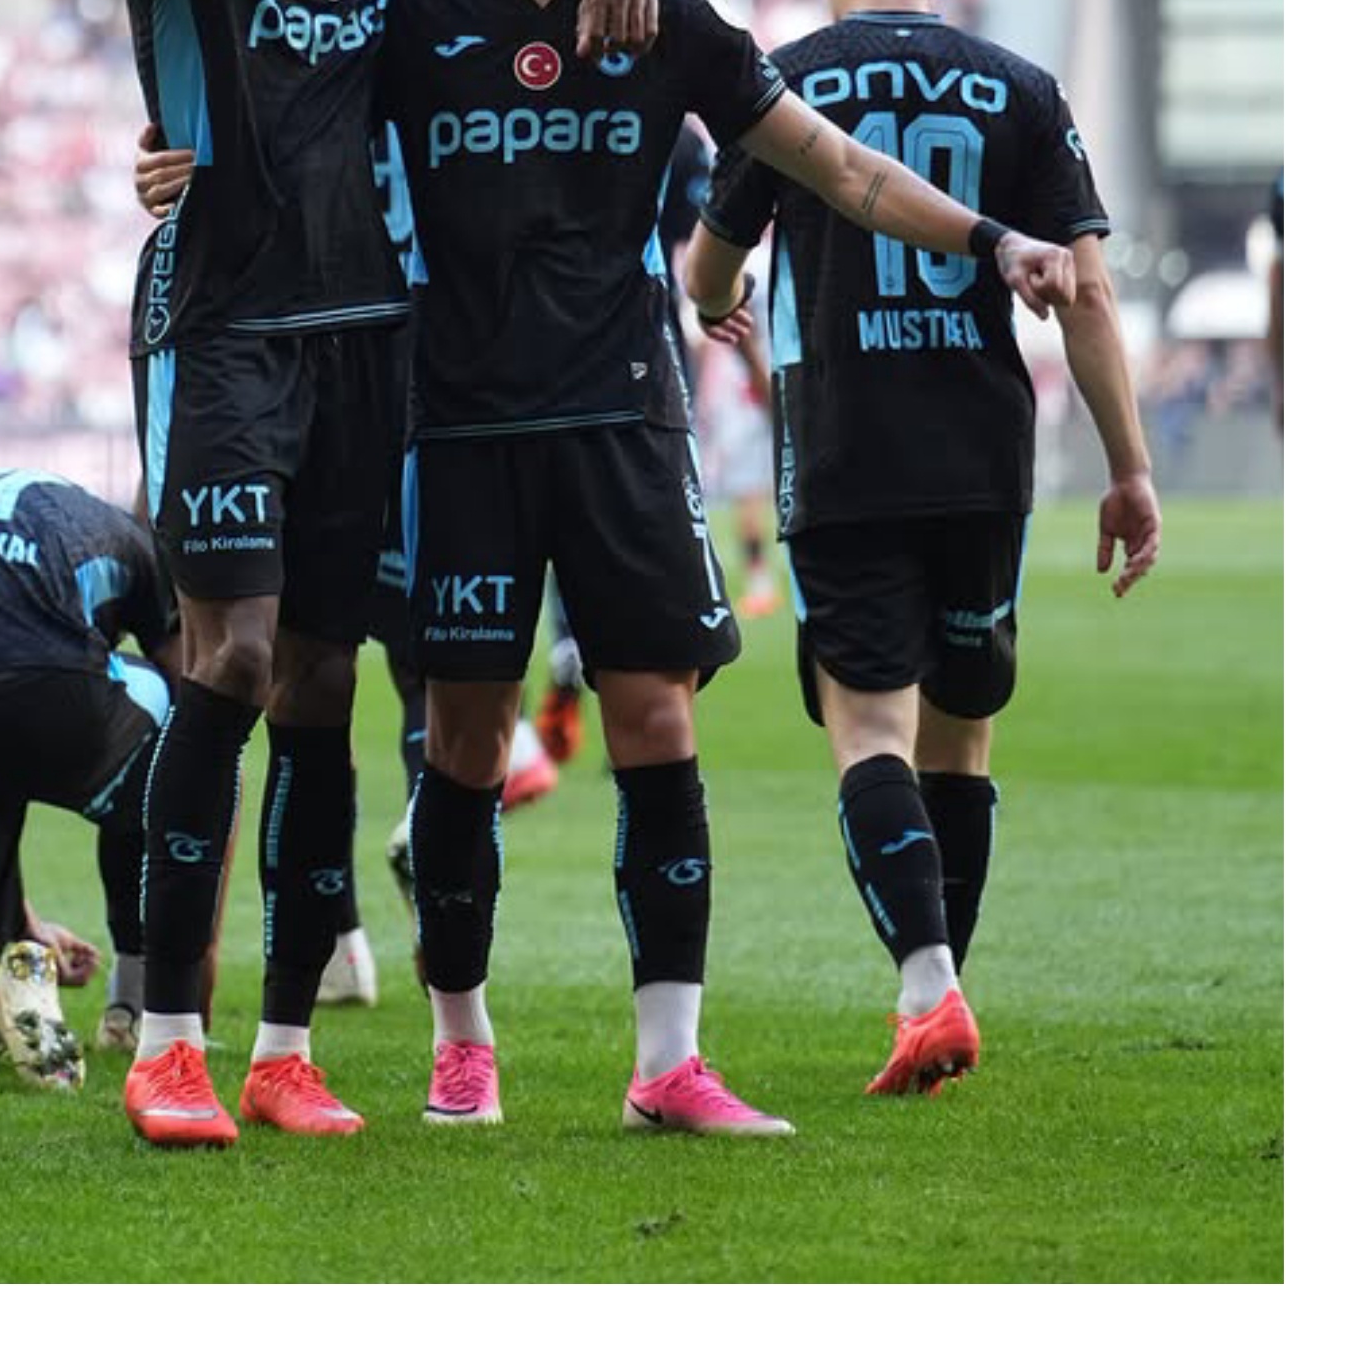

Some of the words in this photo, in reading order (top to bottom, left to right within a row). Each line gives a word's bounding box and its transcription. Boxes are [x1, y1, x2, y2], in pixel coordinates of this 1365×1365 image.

[801, 61, 1009, 115] onvo
[427, 107, 642, 168] papara
[181, 483, 271, 526] YKT
[430, 575, 516, 615] YKT
